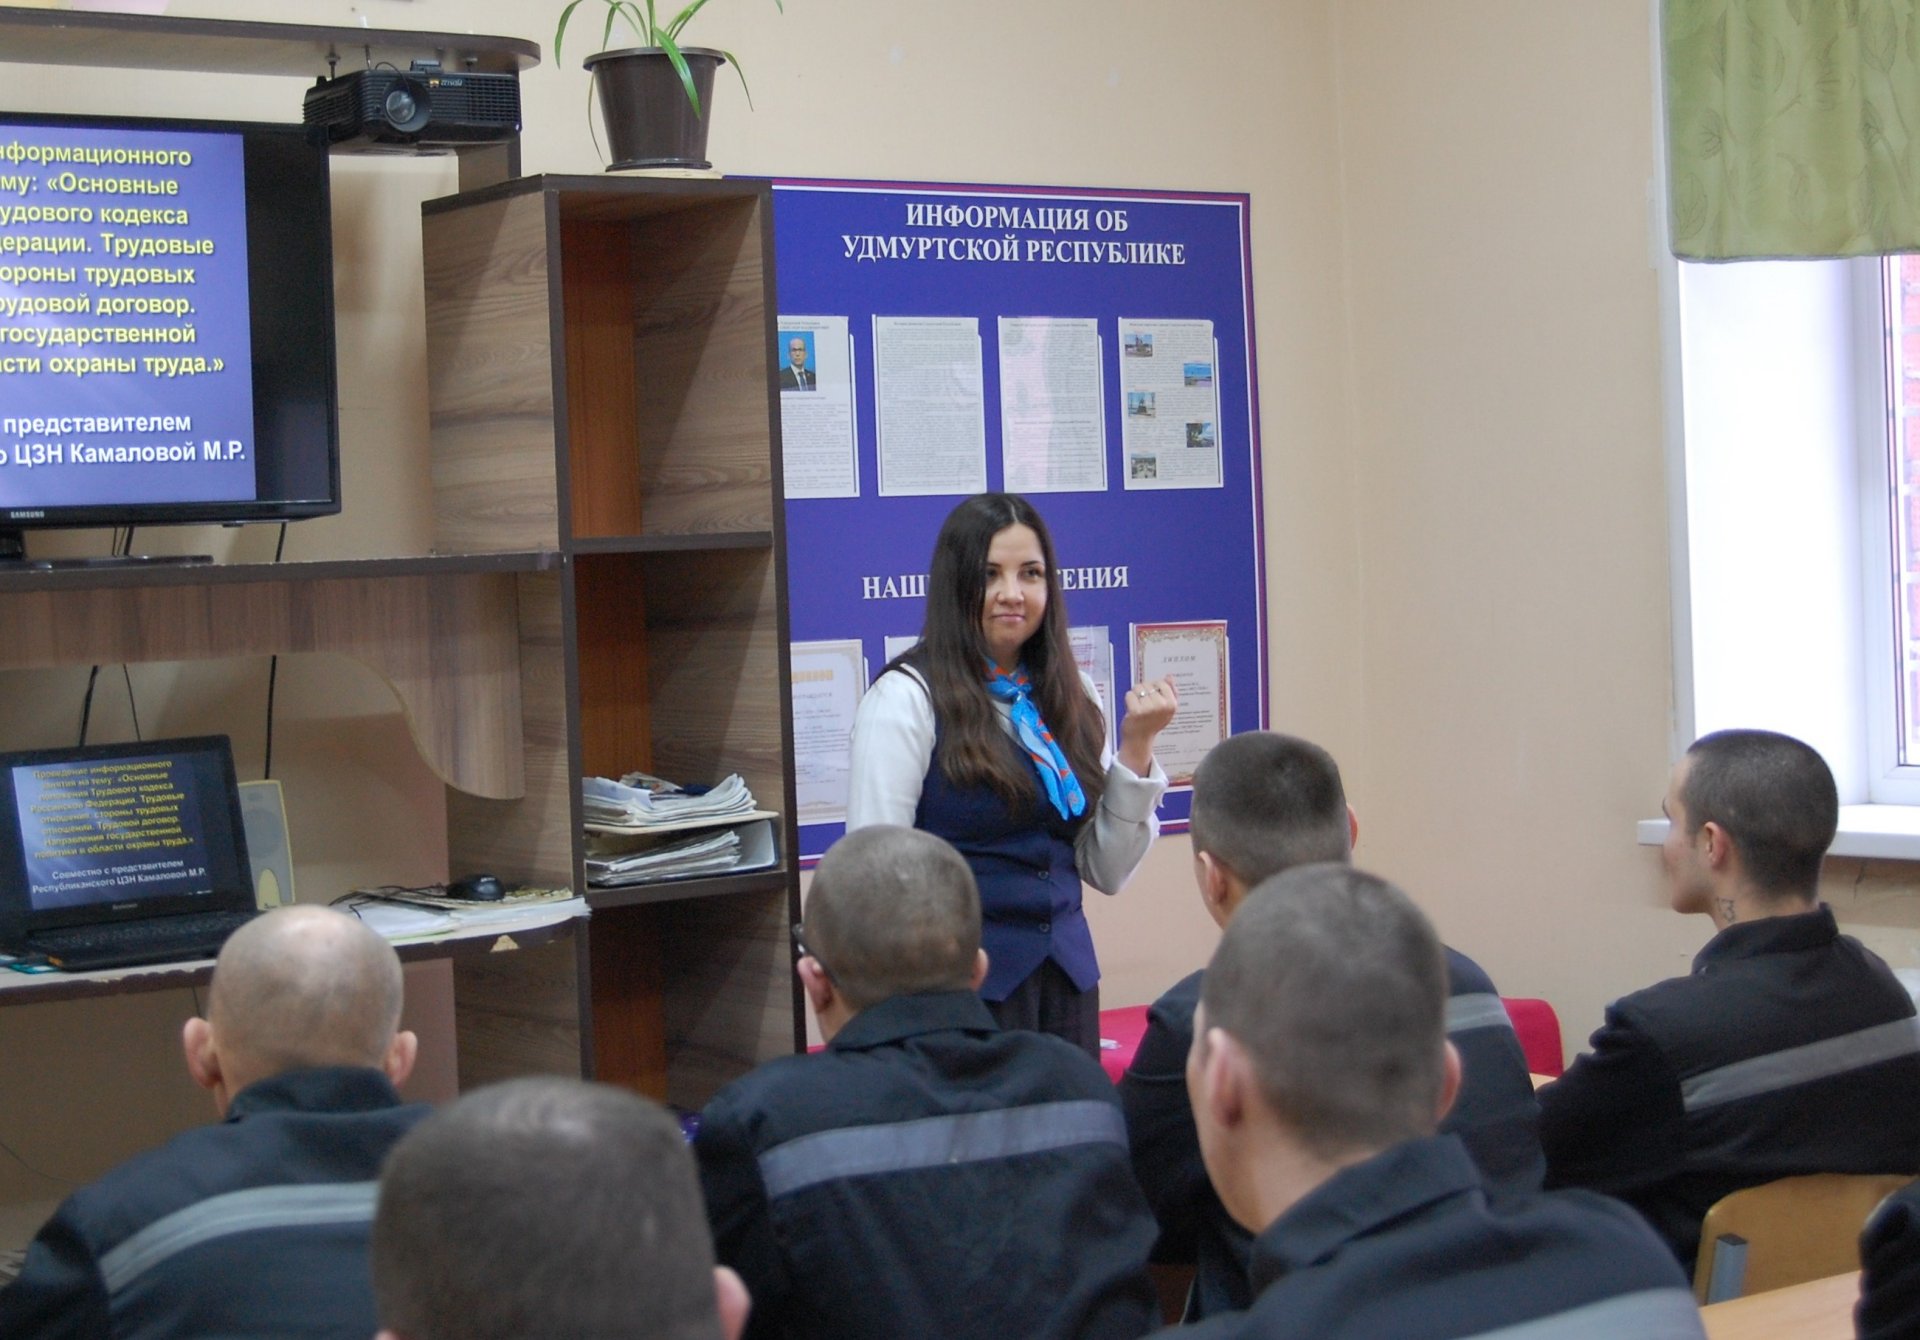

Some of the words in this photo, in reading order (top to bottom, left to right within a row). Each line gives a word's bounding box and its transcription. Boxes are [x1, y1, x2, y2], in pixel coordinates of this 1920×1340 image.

[47, 172, 179, 195] «Основные
[100, 208, 188, 225] кодекса
[906, 203, 1090, 234] ИНФОРМАЦИЯ
[1095, 210, 1129, 232] ОБ
[0, 235, 92, 256] ерации.
[101, 233, 214, 256] Трудовые
[841, 234, 1020, 263] УДМУРТСКОЙ
[1026, 239, 1186, 265] РЕСПУБЛИКЕ
[84, 267, 195, 287] трудовых
[97, 298, 195, 317] договор.
[0, 322, 195, 347] государственной
[50, 356, 136, 377] охраны
[143, 356, 224, 378] труда.»
[4, 415, 192, 438] представителем
[14, 443, 64, 468] ЦЗН
[70, 441, 195, 464] Камаловой
[203, 440, 246, 461] М.Р.
[10, 511, 45, 519] SAMSUNG
[862, 574, 930, 600] НАШ
[1056, 566, 1129, 590] ЕНИЯ
[90, 761, 172, 774] информационного
[91, 786, 137, 797] Трудового
[141, 793, 184, 804] Трудовые
[135, 804, 178, 816] трудовых
[52, 868, 102, 880] Совместно
[104, 867, 110, 875] с
[111, 860, 184, 876] представителем
[32, 880, 116, 894] Республиканского
[117, 876, 137, 887] ЦЗН
[137, 871, 187, 883] Камаловой
